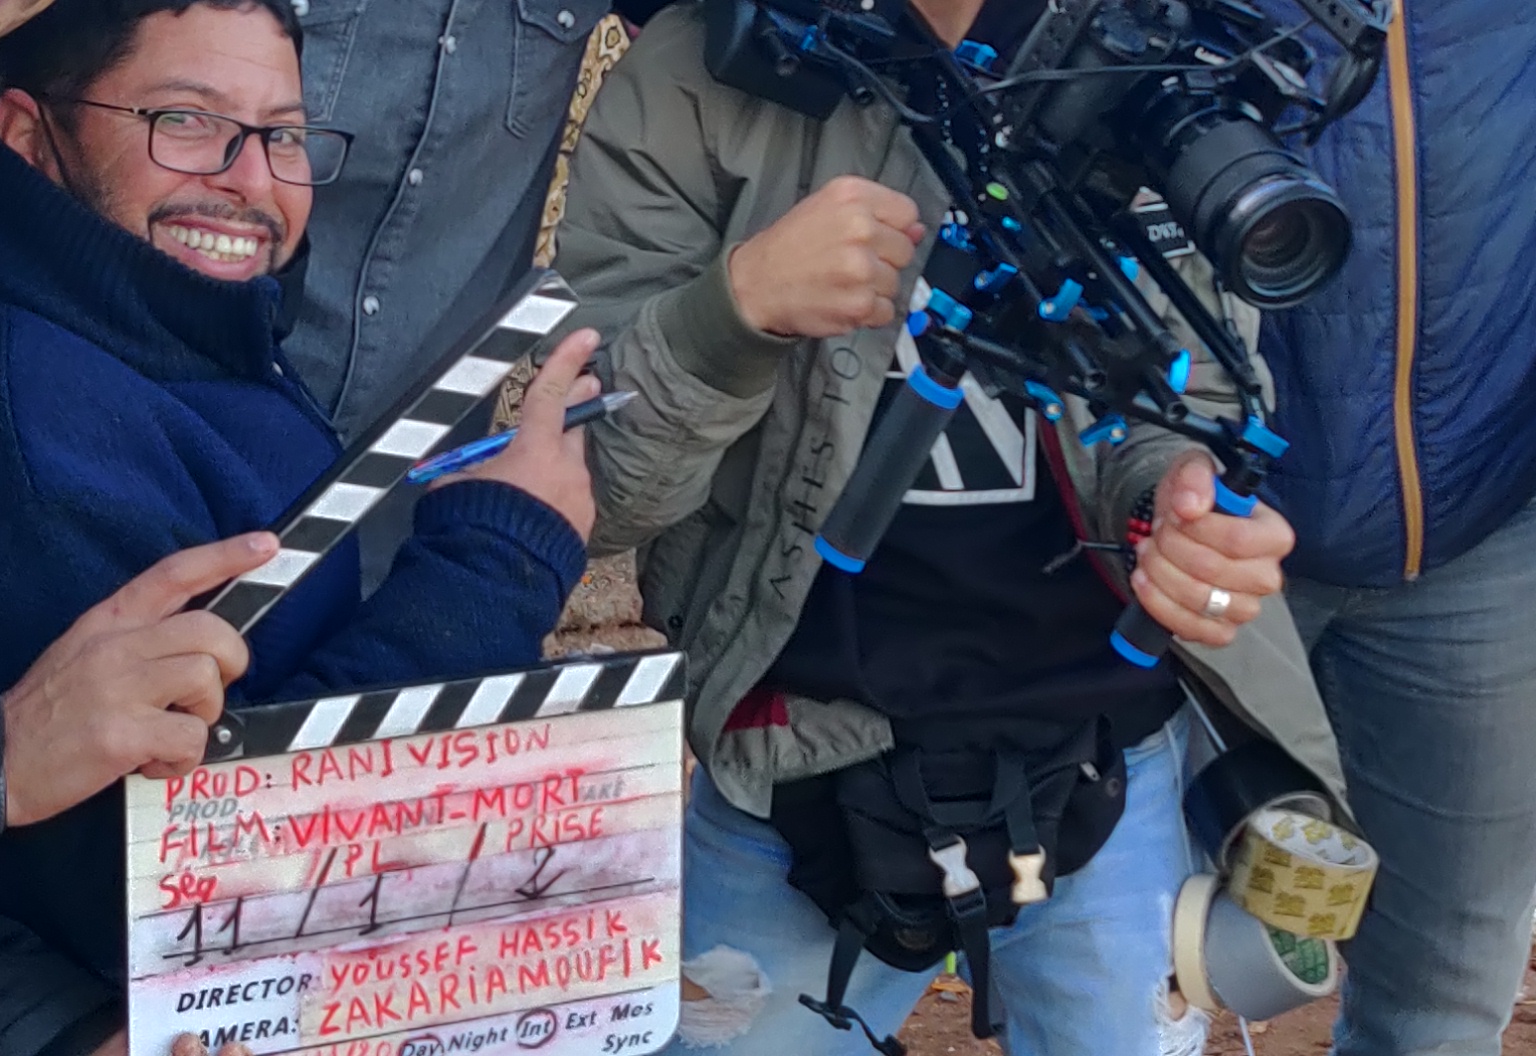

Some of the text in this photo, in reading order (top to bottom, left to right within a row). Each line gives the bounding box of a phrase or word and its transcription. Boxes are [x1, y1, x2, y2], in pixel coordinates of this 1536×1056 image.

[291, 738, 393, 792] RANI
[405, 722, 551, 770] VISION
[344, 839, 409, 878] PL
[198, 1016, 300, 1048] AMERA:
[447, 1026, 509, 1055] Night
[519, 1019, 551, 1039] Int
[564, 1010, 598, 1030] Ext
[601, 1028, 654, 1053] Sync
